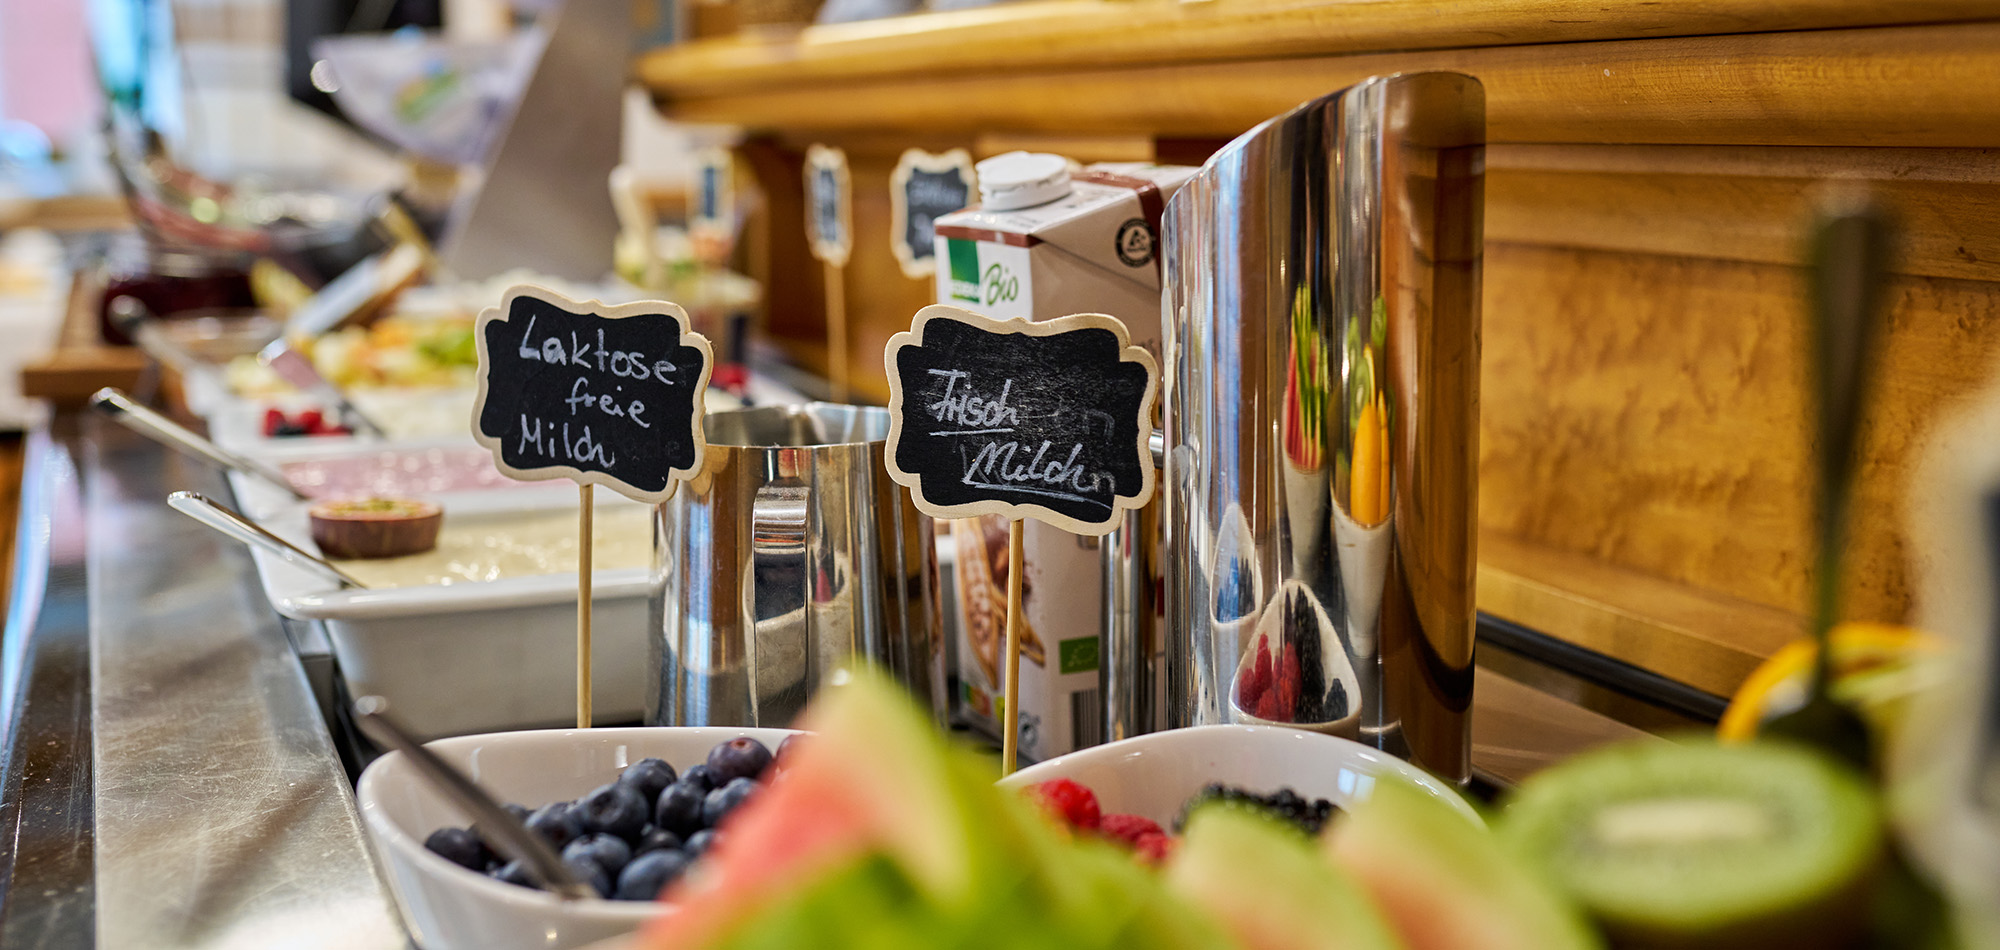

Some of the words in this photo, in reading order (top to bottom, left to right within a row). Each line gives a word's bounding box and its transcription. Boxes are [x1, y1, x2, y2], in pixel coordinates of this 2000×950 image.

[984, 262, 1019, 307] Bio
[519, 314, 677, 385] Laktose
[565, 376, 650, 428] freie
[518, 413, 615, 468] Milch
[962, 440, 1094, 493] Milch
